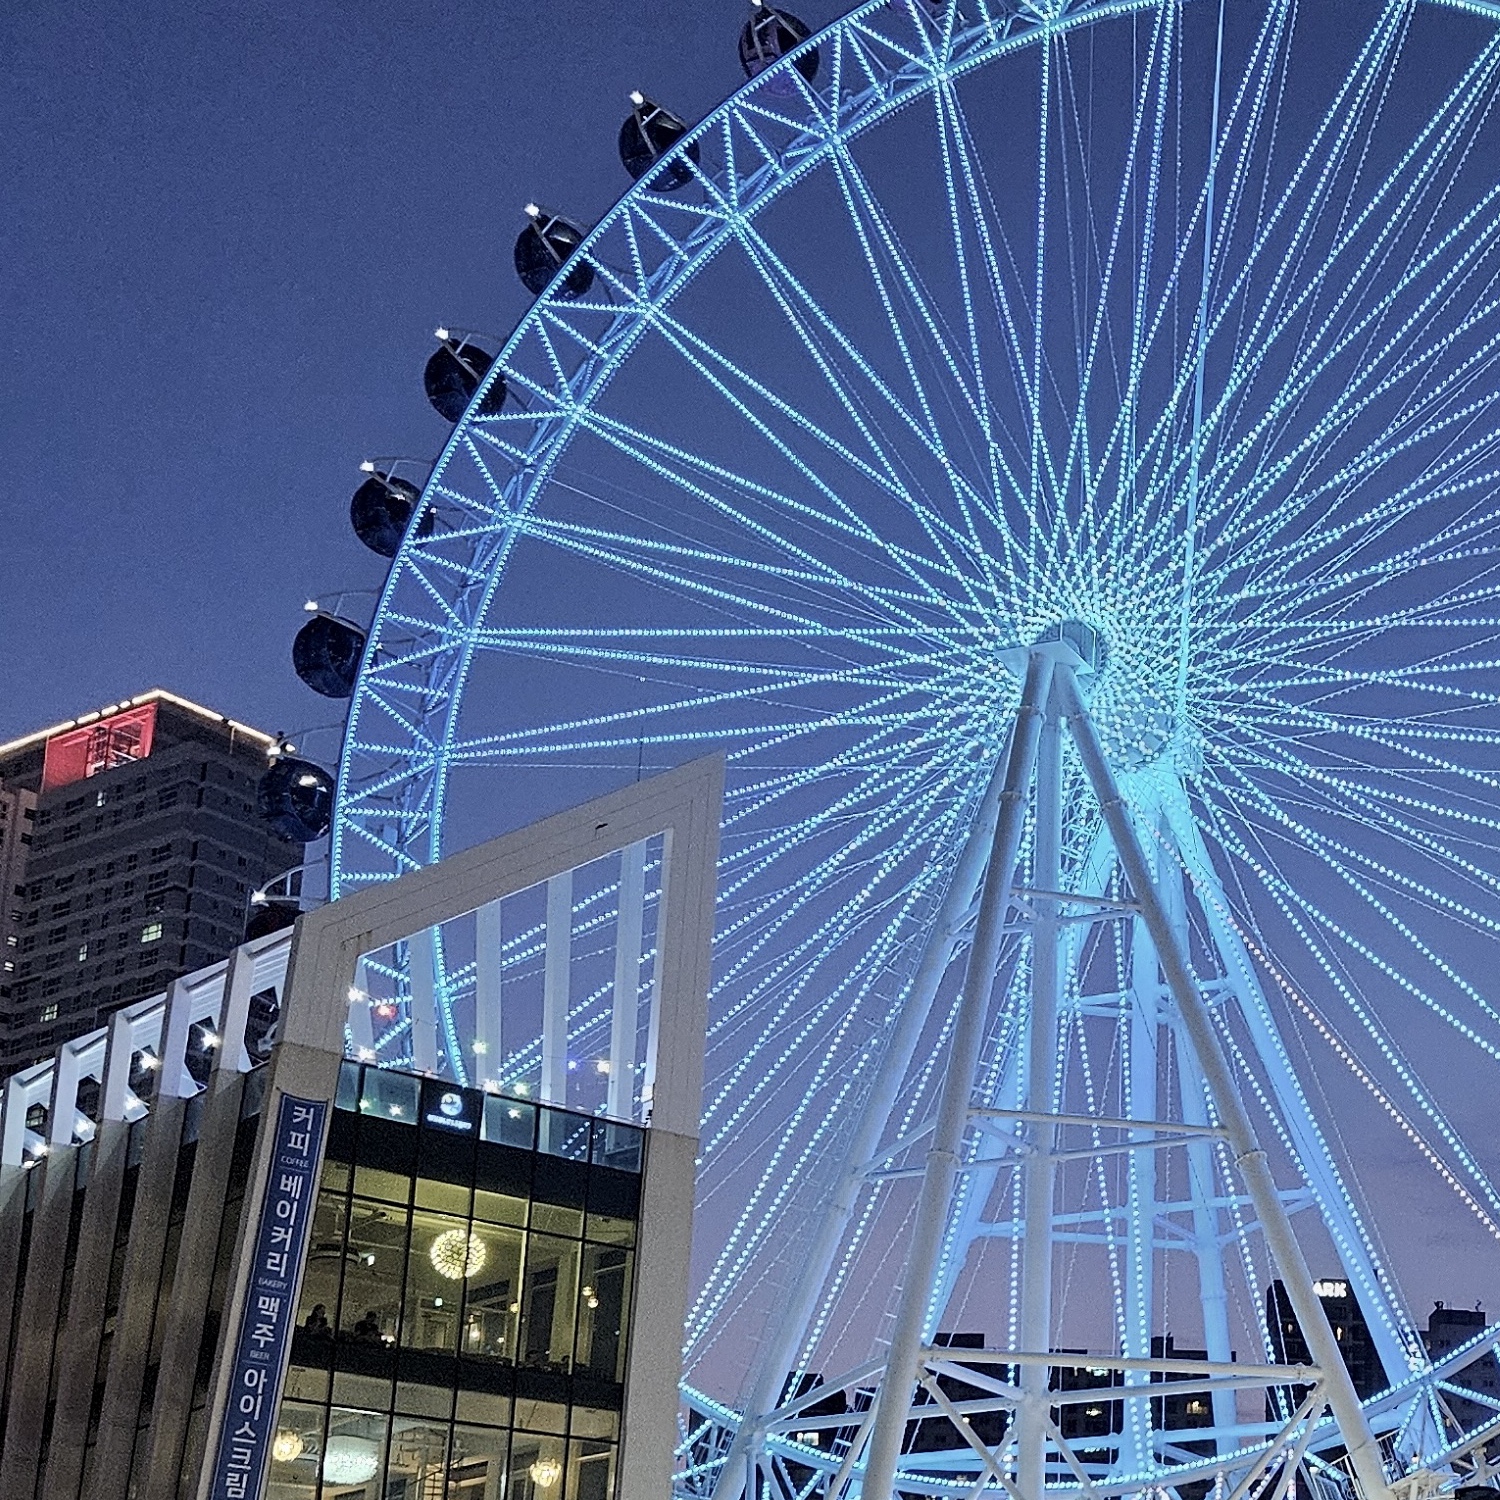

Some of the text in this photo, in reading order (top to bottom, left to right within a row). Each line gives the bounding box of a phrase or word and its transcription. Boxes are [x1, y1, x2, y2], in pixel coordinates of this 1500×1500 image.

[288, 1106, 314, 1157] 커피
[281, 1155, 309, 1168] COFFEE
[266, 1174, 303, 1278] 베이커리
[258, 1277, 288, 1290] BAKERY
[252, 1296, 281, 1349] 맥주
[250, 1350, 270, 1360] BEER
[225, 1369, 268, 1499] 아이스크림
